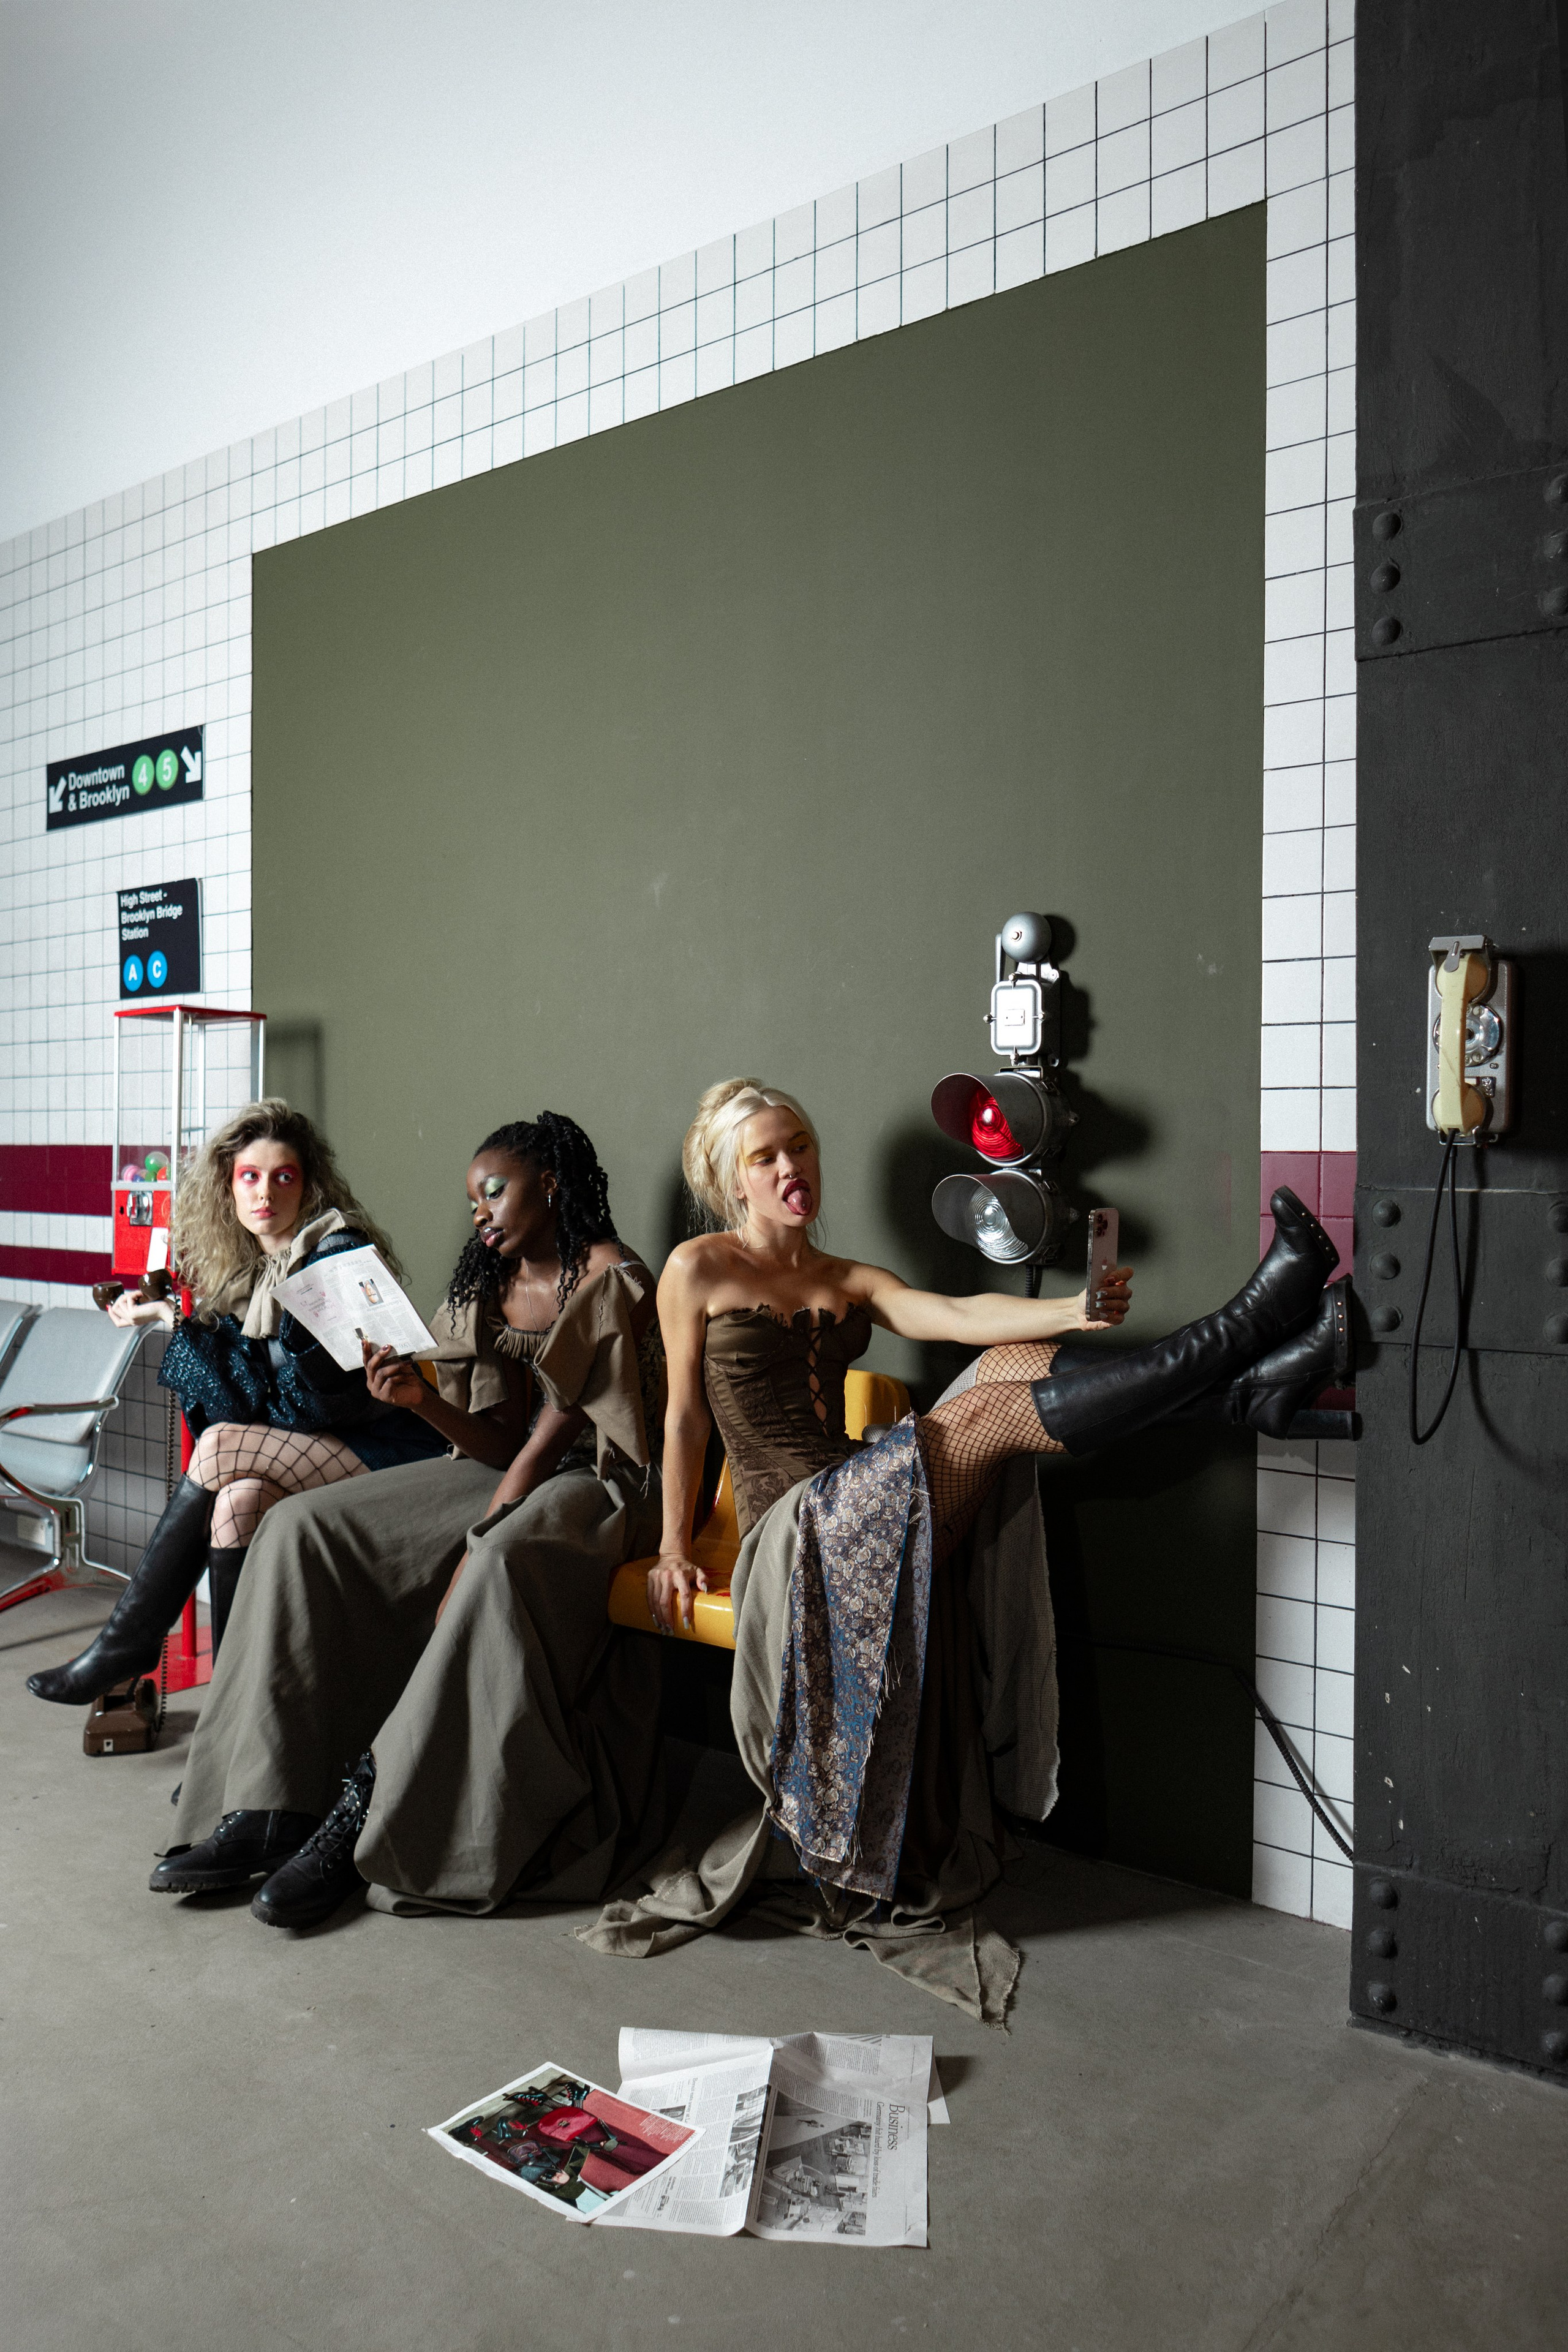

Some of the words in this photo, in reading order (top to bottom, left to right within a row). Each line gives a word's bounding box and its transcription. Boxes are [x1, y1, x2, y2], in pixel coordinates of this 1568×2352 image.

[68, 764, 125, 791] Downtown
[138, 763, 148, 787] 4
[162, 757, 172, 782] 5
[67, 793, 77, 812] &
[79, 783, 130, 810] Brooklyn
[120, 892, 138, 909] High
[139, 889, 163, 905] Street
[121, 908, 156, 924] Brooklyn
[156, 903, 183, 920] Bridge
[122, 925, 149, 941] Station
[128, 963, 137, 981] A
[153, 960, 162, 979] C
[874, 2101, 884, 2127] Germany
[888, 2103, 905, 2150] Business
[874, 2135, 883, 2149] hard
[873, 2156, 881, 2166] loss
[872, 2173, 881, 2187] trade
[872, 2187, 880, 2198] fairs
